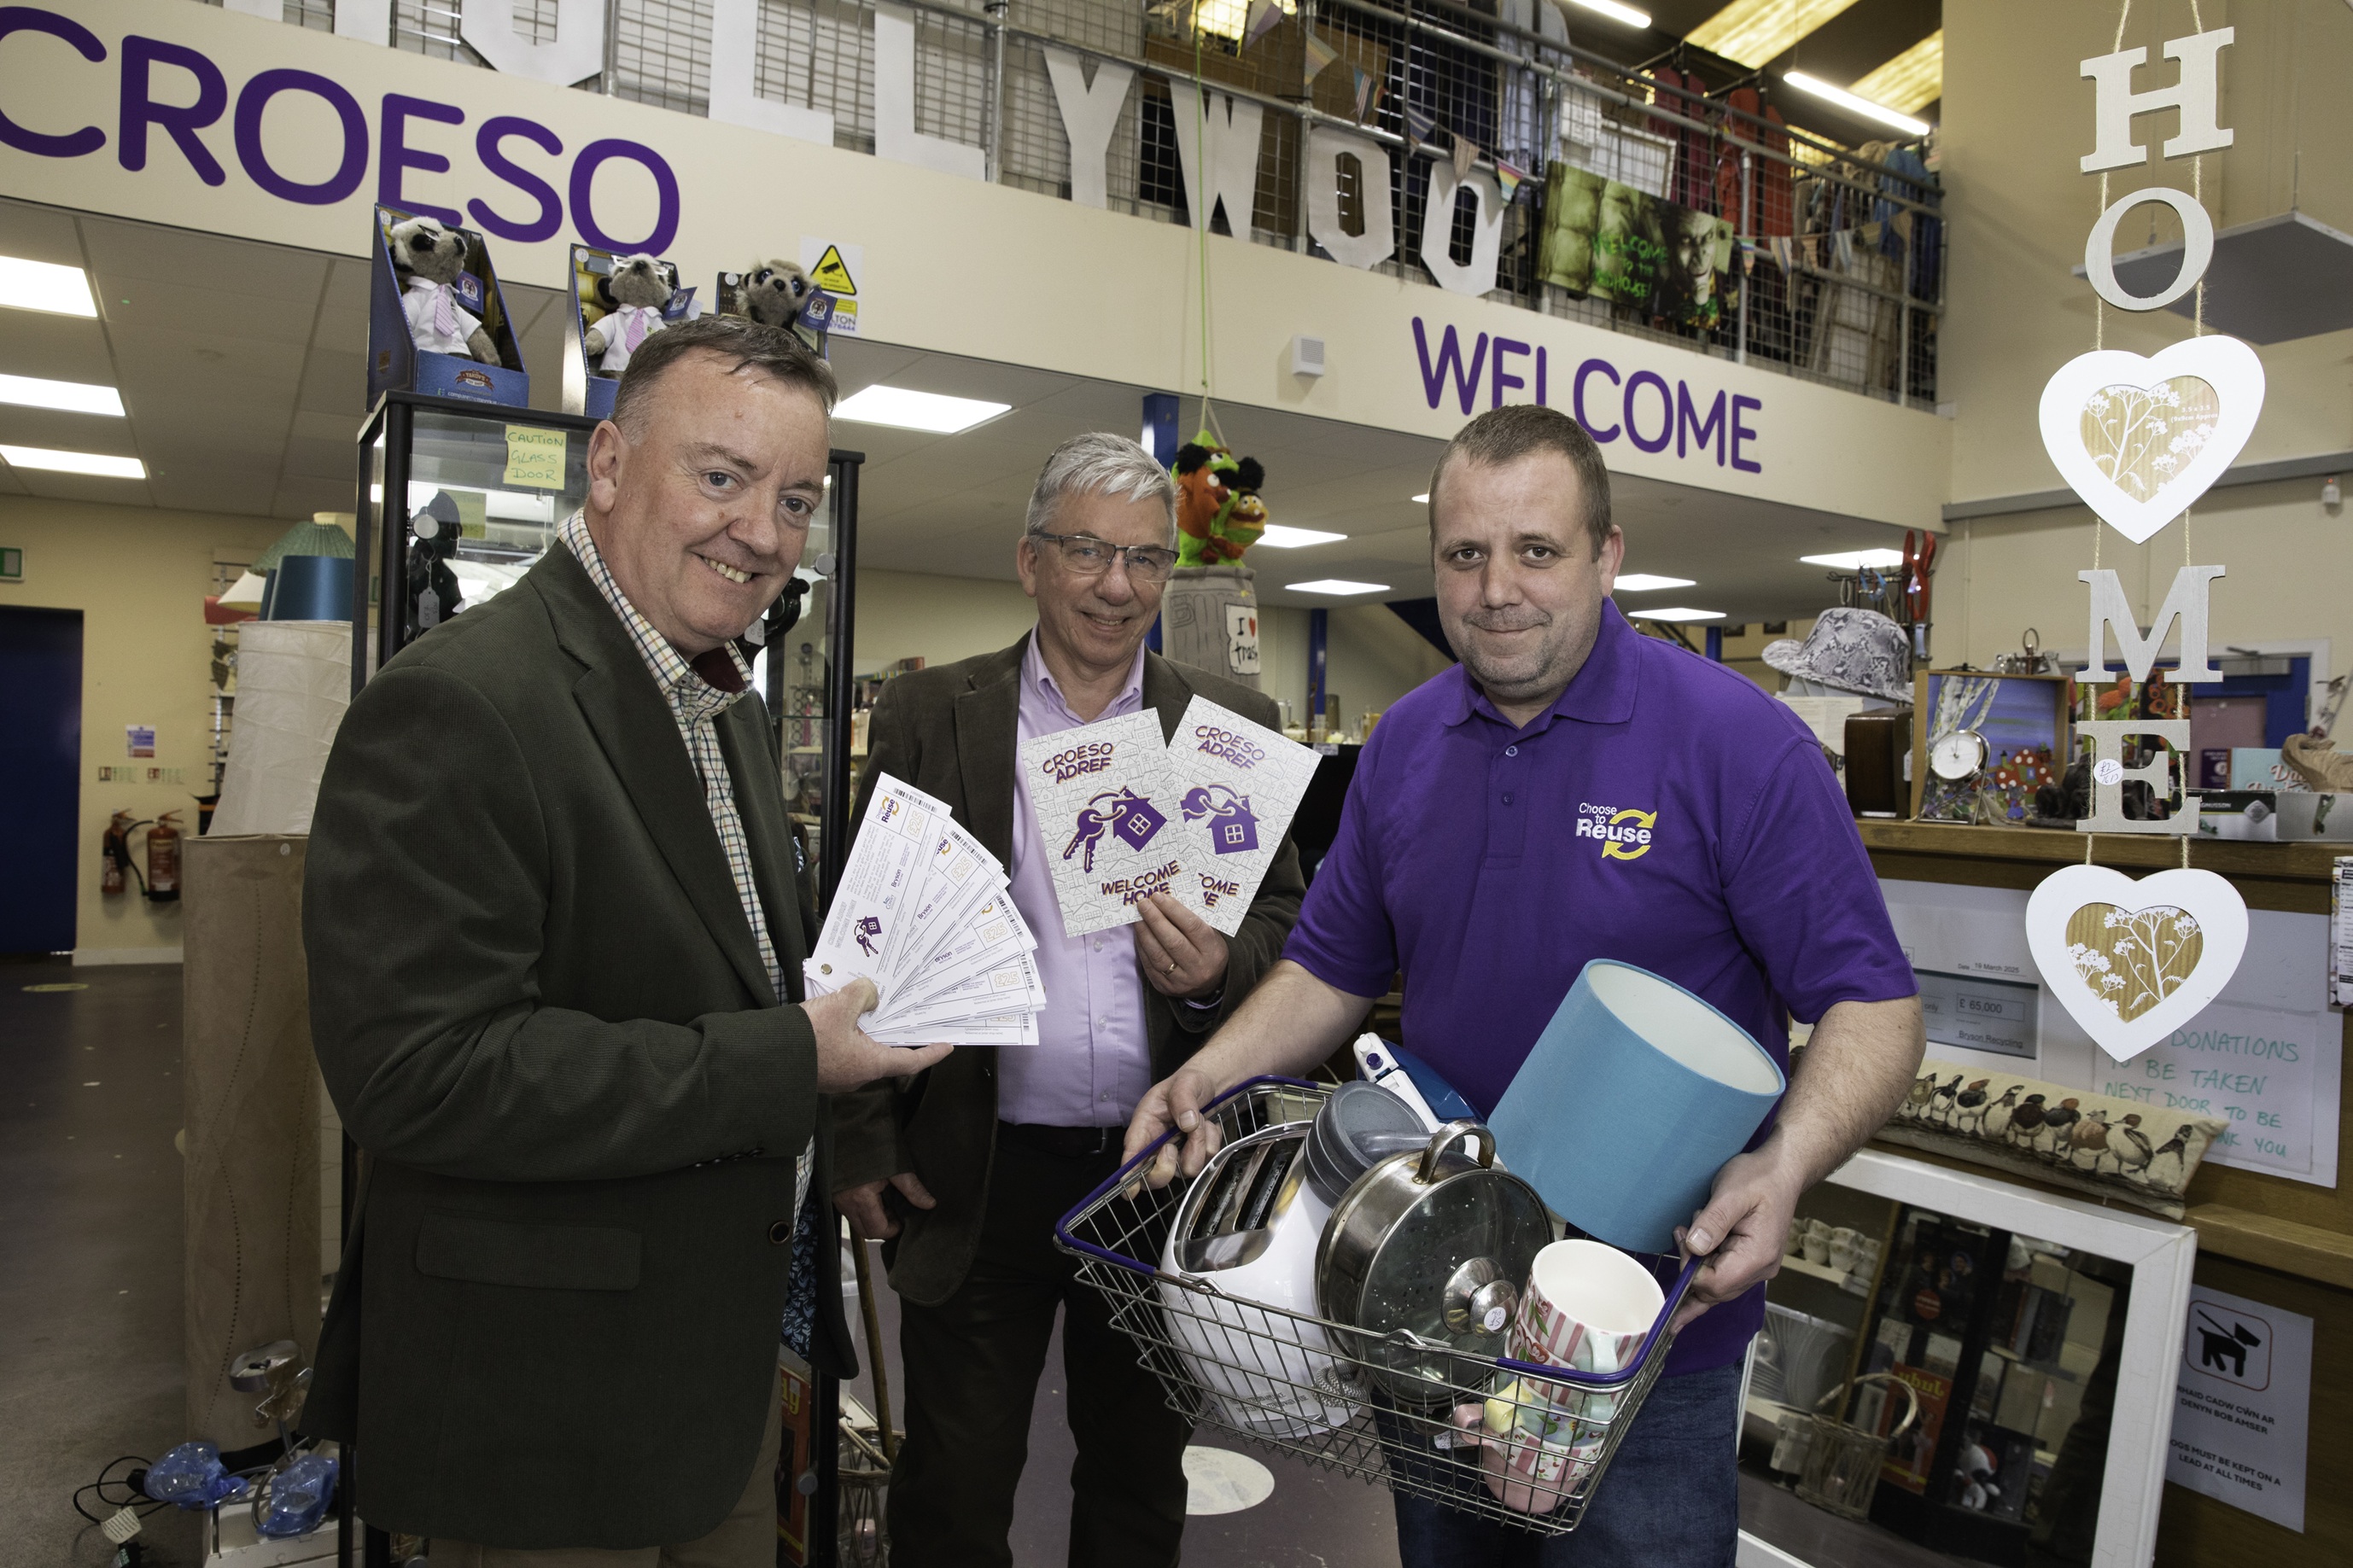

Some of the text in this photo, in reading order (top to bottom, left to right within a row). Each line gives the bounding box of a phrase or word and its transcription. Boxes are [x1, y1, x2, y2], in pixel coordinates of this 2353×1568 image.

[0, 7, 680, 258] CROESO
[508, 432, 564, 447] CAUTION
[511, 450, 558, 465] GLASS
[513, 468, 556, 481] DOOR
[1194, 726, 1265, 761] CROESO
[1197, 739, 1256, 770] ADREF
[1042, 742, 1114, 775] CROESO
[1055, 757, 1112, 784] ADREF
[881, 799, 895, 823] Reuse
[1579, 802, 1618, 815] Choose
[1595, 813, 1606, 825] to
[907, 810, 925, 838] £25
[1575, 819, 1651, 844] Reuse
[890, 868, 902, 887] Bryson
[951, 856, 973, 882] £25
[1101, 860, 1182, 896] WELCOME
[1123, 883, 1171, 906] HOME
[917, 903, 932, 920] Bryson
[984, 922, 1007, 943] £25
[934, 951, 953, 963] Bryson
[1983, 963, 2003, 971] March
[994, 971, 1020, 988] £25
[1924, 999, 2003, 1014] only £ 65,000
[1959, 1029, 2023, 1049] Bryson Recycling
[2171, 1029, 2299, 1063] DONATIONS
[2146, 1059, 2176, 1080] BE
[2191, 1070, 2268, 1095] TAKEN
[2105, 1081, 2282, 1129] NEXT DOOR TO BE
[2254, 1137, 2287, 1157] YOU
[2181, 1398, 2268, 1435] DENYN BOB AMSER
[2205, 1396, 2234, 1414] CADW
[2261, 1414, 2275, 1425] AR
[2169, 1439, 2281, 1486] OGS MUST BE KEPT ON A
[2179, 1454, 2263, 1491] LEAD AT ALL TIMES
